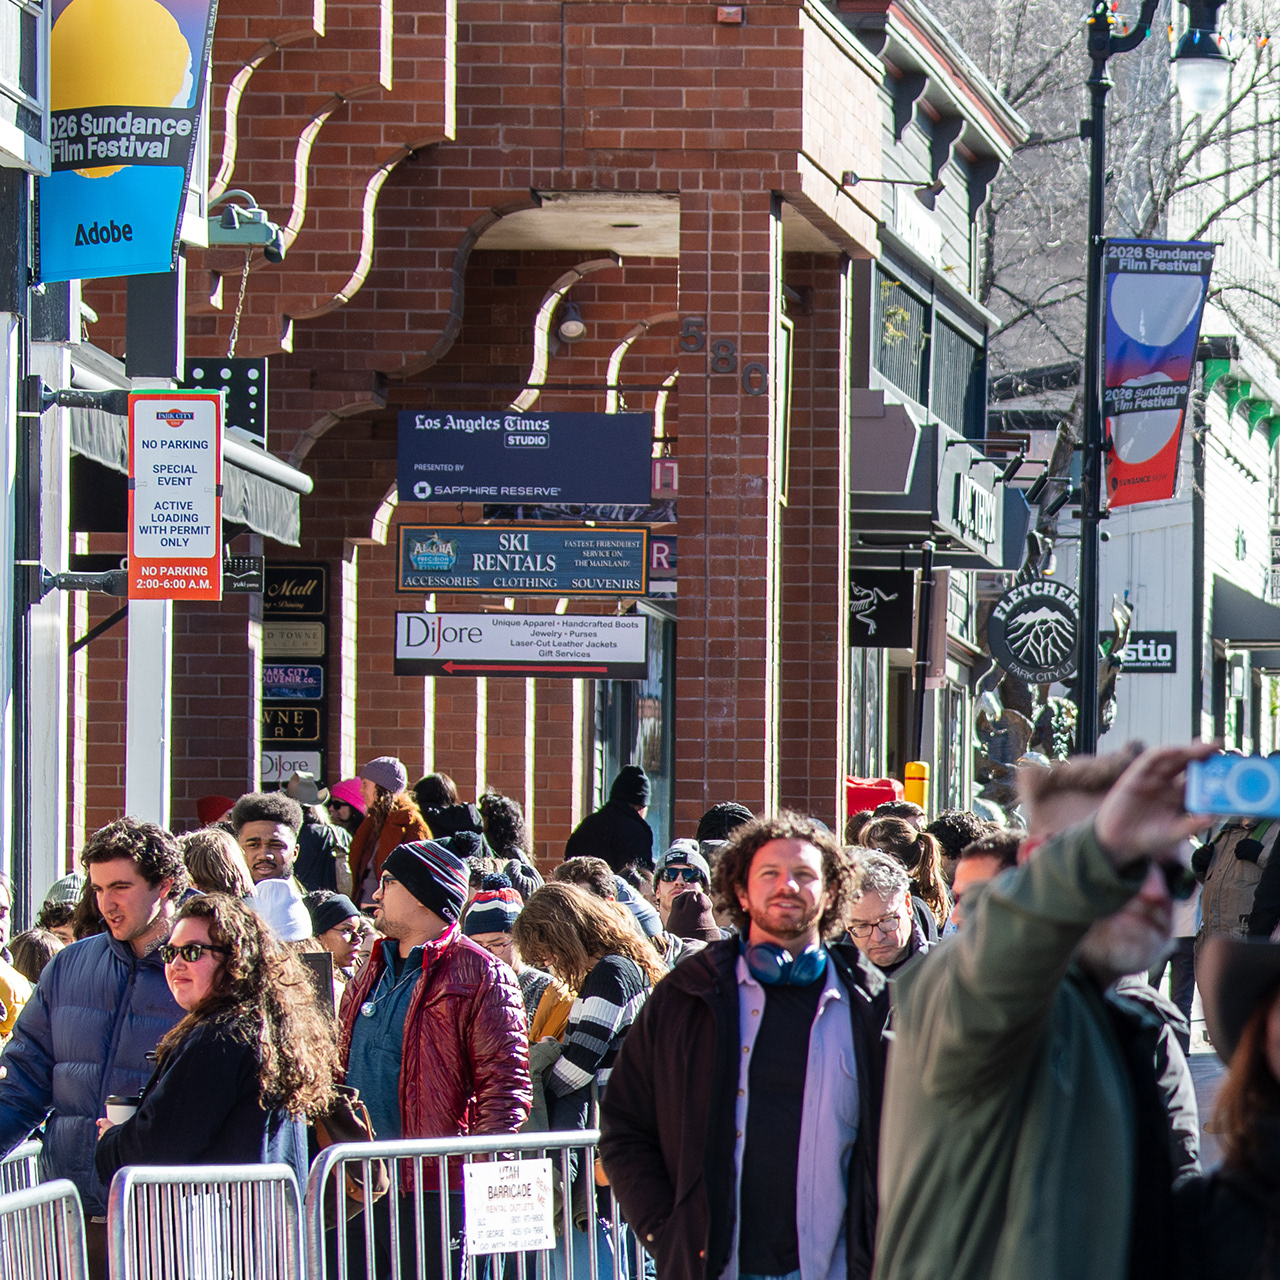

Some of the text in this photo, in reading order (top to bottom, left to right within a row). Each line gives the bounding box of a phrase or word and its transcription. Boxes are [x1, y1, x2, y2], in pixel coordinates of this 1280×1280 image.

[81, 111, 192, 136] Sundance
[51, 136, 170, 163] Film Festival
[75, 219, 133, 246] Adobe
[1109, 247, 1212, 260] 2026 Sundance
[1119, 259, 1202, 272] Film Festival
[680, 316, 768, 396] 580
[1105, 385, 1187, 401] 2026 Sundance
[1135, 396, 1177, 410] Festival
[158, 412, 193, 420] PARK CITY
[415, 415, 550, 433] Los Angeles Times
[142, 440, 209, 449] NO PARKING
[508, 435, 546, 446] STUDIO
[152, 465, 198, 474] SPECIAL
[158, 477, 193, 486] EVENT
[434, 486, 497, 495] SAPPHIRE
[154, 501, 193, 510] ACTIVE
[151, 514, 199, 523] LOADING
[139, 526, 211, 535] WITH PERMIT
[160, 538, 190, 547] ONLY
[499, 533, 529, 551] SKI
[413, 542, 454, 556] ALOHA
[473, 554, 556, 572] RENTALS
[574, 559, 588, 567] THE
[141, 567, 208, 576] NO PARKING
[136, 579, 213, 589] 2:00-6:00 A.M.
[268, 579, 317, 597] Mall
[404, 577, 640, 589] ACCESSORIES CLOTHING SOUVENIRS
[492, 619, 639, 629] Unique Apparel Handcrafted Boots
[278, 631, 319, 640] TOWNE
[530, 630, 597, 639] Jewelry Purses
[510, 639, 617, 649] Laser-Cut Leather Jackets
[538, 649, 590, 658] Gift Services
[1125, 639, 1172, 662] stio
[288, 668, 309, 677] CITY
[1008, 662, 1075, 682] PARK CITY UT
[262, 674, 301, 683] OUVENIR
[488, 1183, 532, 1200] BARRICADE
[486, 1203, 535, 1213] RENTAL OUTLETS
